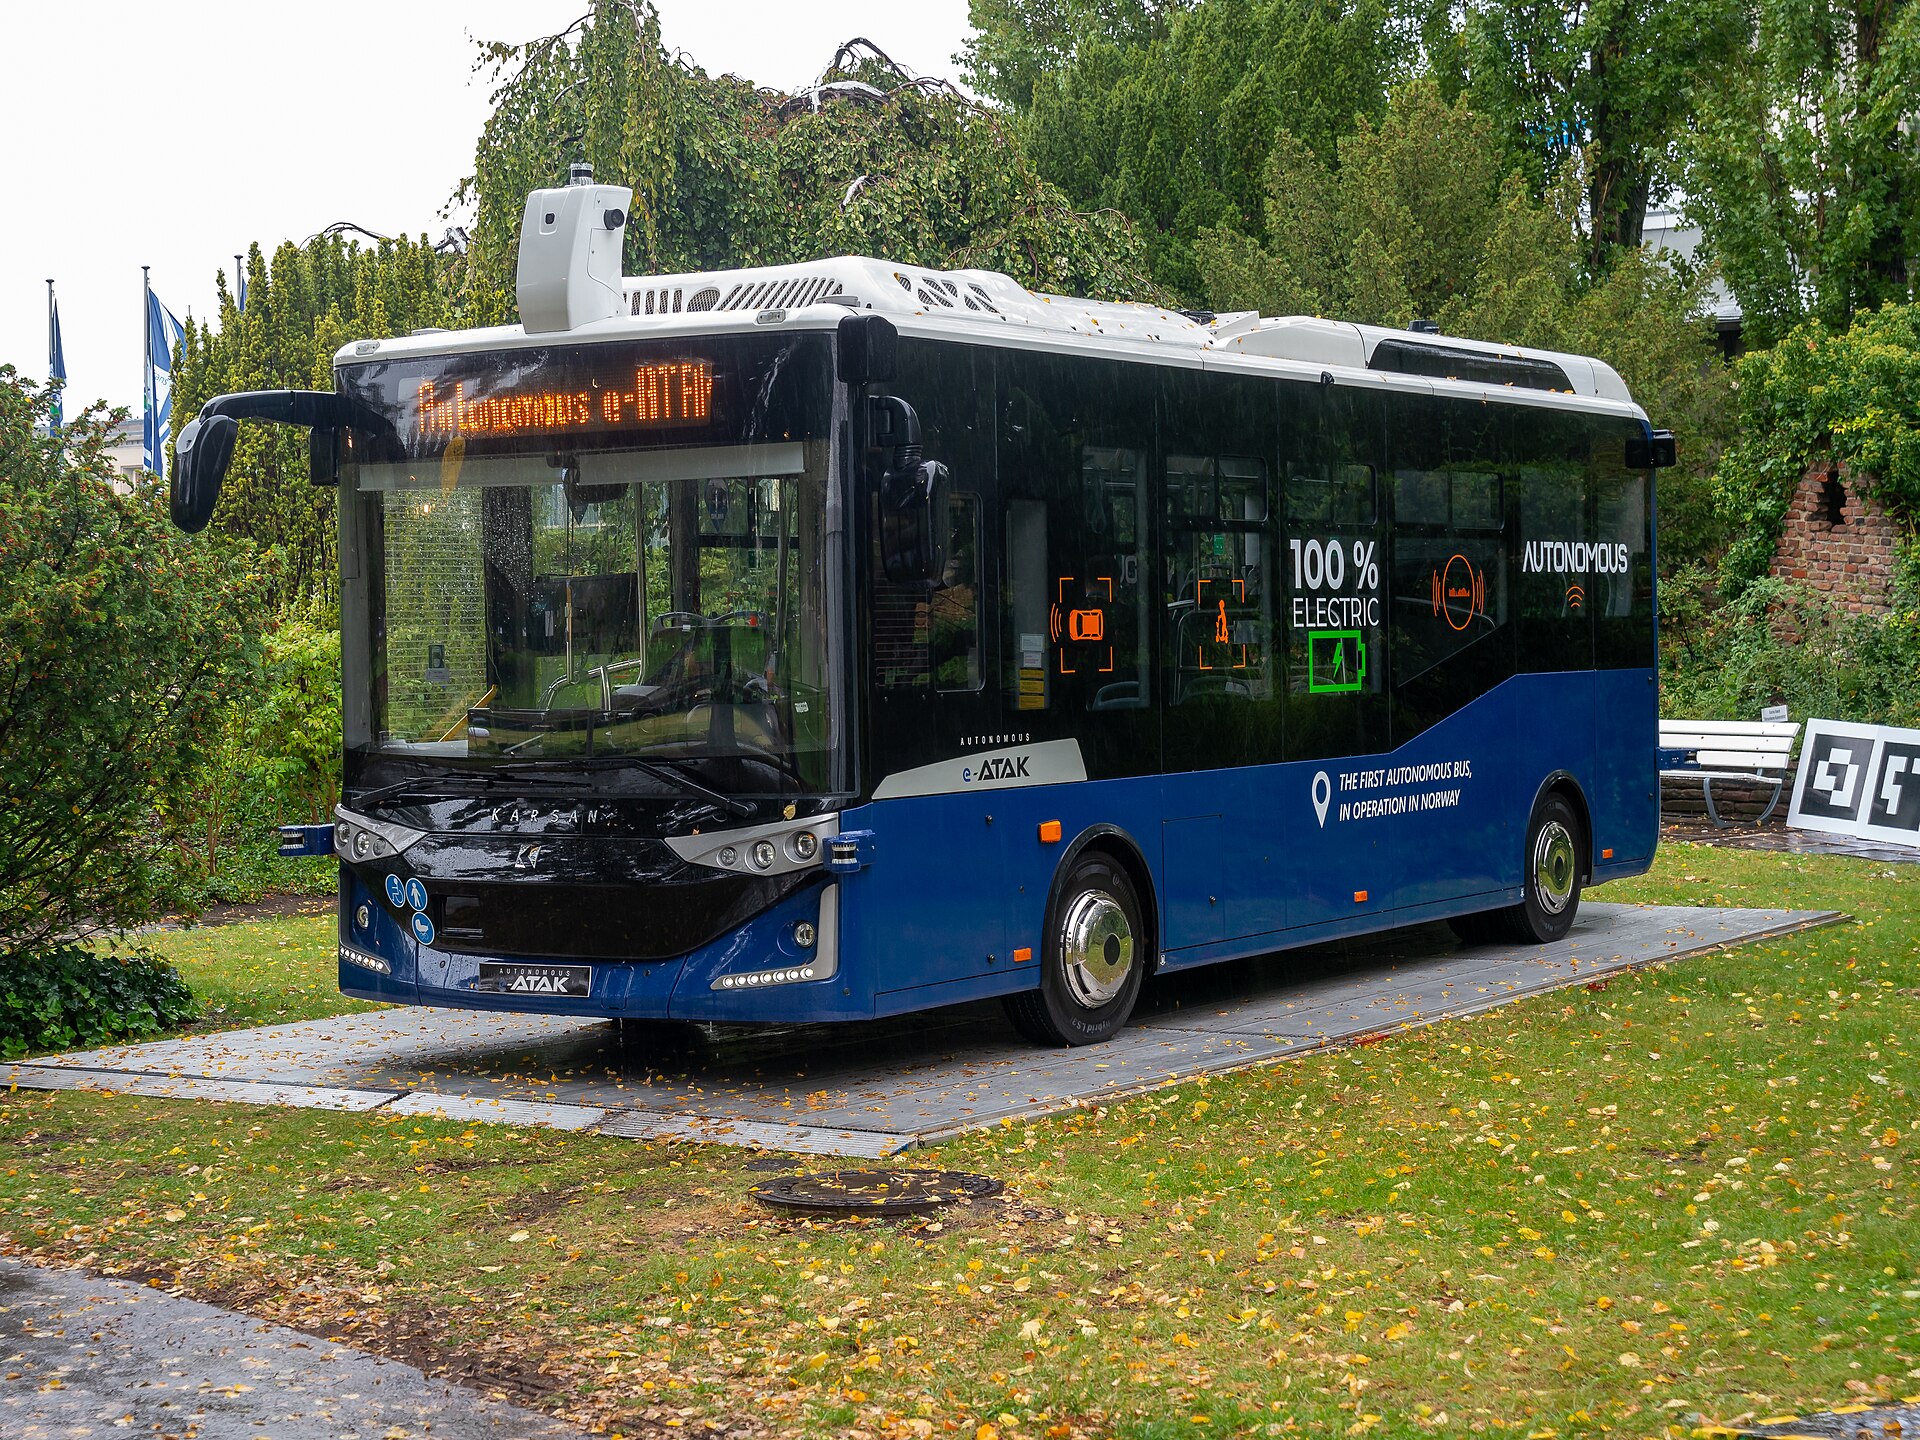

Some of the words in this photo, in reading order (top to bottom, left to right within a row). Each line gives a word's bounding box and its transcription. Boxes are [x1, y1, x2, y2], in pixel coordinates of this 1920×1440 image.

[418, 381, 592, 434] Autonomous
[1289, 538, 1345, 590] 100
[1353, 540, 1379, 590] %
[1522, 541, 1628, 573] AUTONOMOUS
[1293, 597, 1380, 628] ELECTRIC
[960, 733, 1030, 746] AUTONOMOUS
[963, 756, 1031, 782] e-ATAK
[1339, 773, 1358, 792] THE
[1359, 769, 1385, 789] FIRST
[1386, 761, 1452, 786] AUTONOMOUS
[1453, 760, 1472, 779] BUS,
[491, 807, 598, 823] KARSAN
[1339, 803, 1351, 821] IN
[1352, 796, 1407, 820] OPERATION
[1408, 794, 1419, 813] IN
[1420, 789, 1461, 811] NORWAY
[499, 967, 571, 977] AUTONOMOUS
